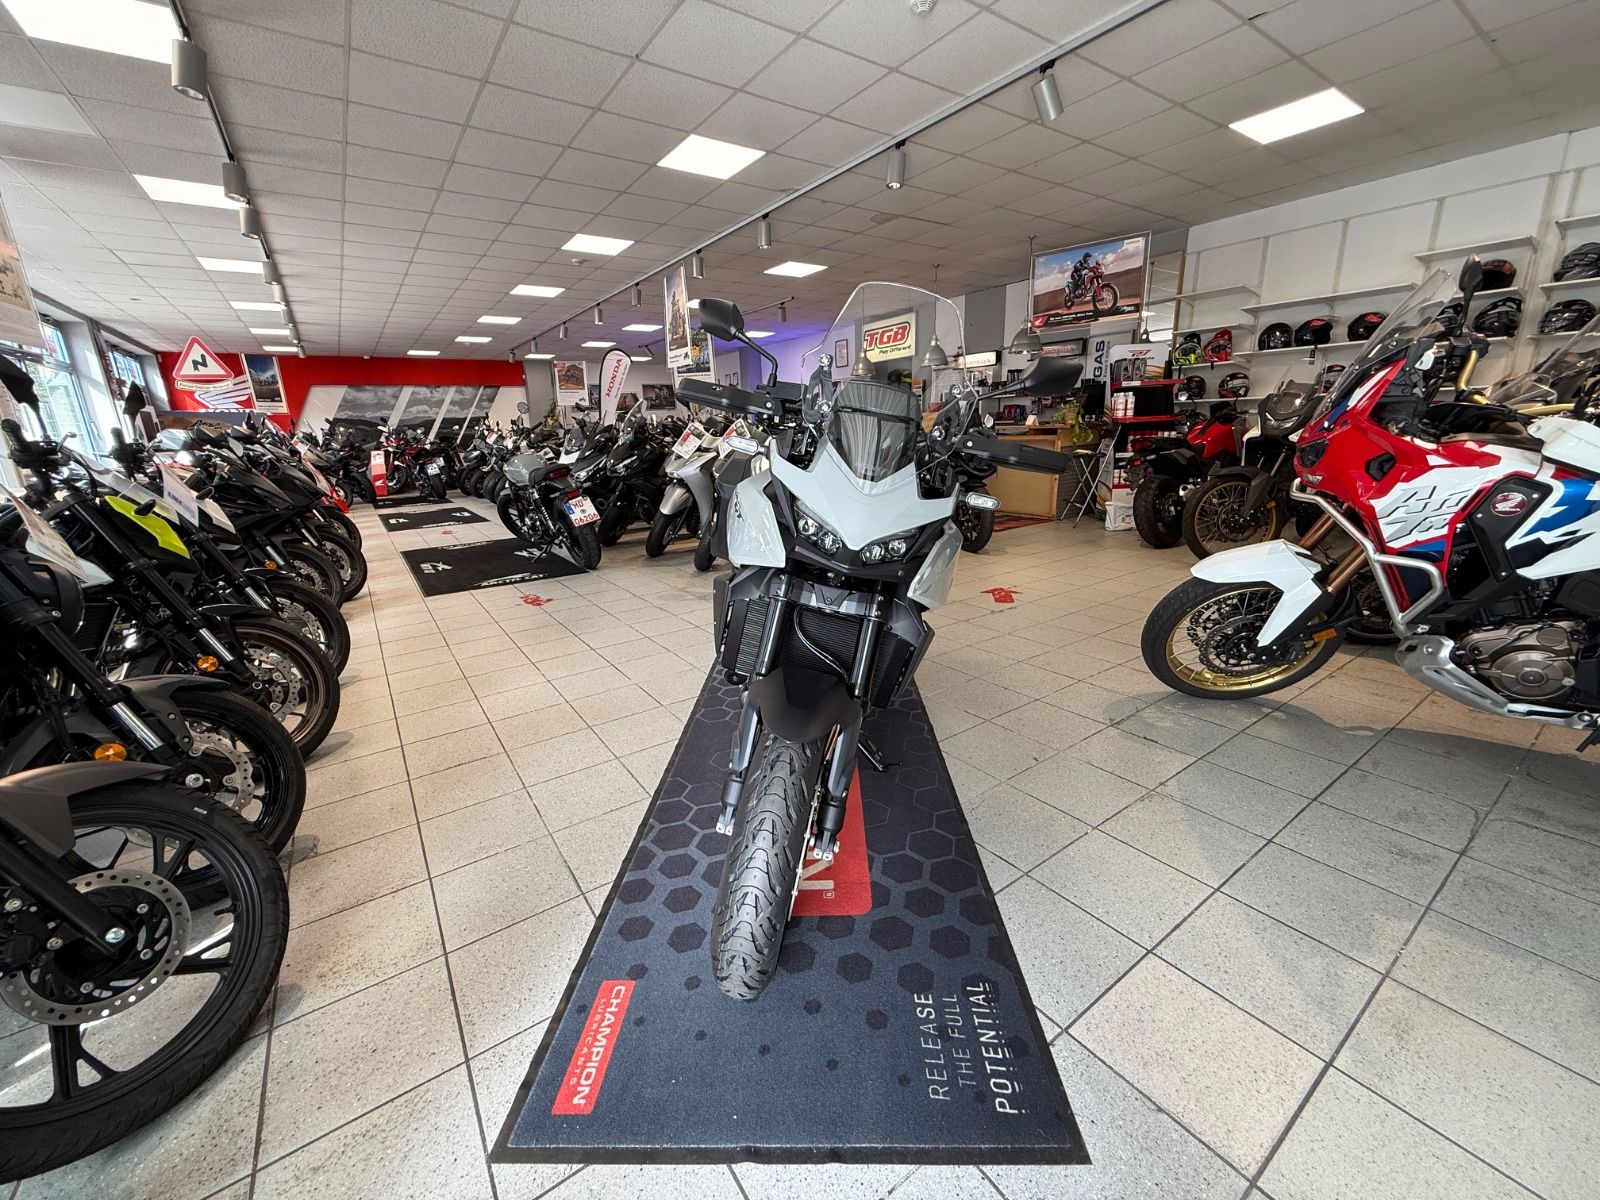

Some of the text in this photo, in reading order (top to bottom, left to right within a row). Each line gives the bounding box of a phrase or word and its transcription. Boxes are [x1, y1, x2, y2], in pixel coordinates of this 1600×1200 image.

[865, 323, 909, 351] TGB
[1043, 346, 1076, 354] HONDA
[605, 358, 623, 398] HONDA
[1093, 340, 1105, 378] GAS
[572, 499, 584, 510] MD
[573, 512, 599, 526] 06206
[480, 577, 523, 587] ARCTIC
[569, 998, 608, 1085] LUBRICANTS
[572, 985, 626, 1105] CHAMPION
[914, 993, 951, 1101] RELEASE
[942, 994, 977, 1088] THE FULL
[966, 982, 1019, 1114] POTENTIAL
